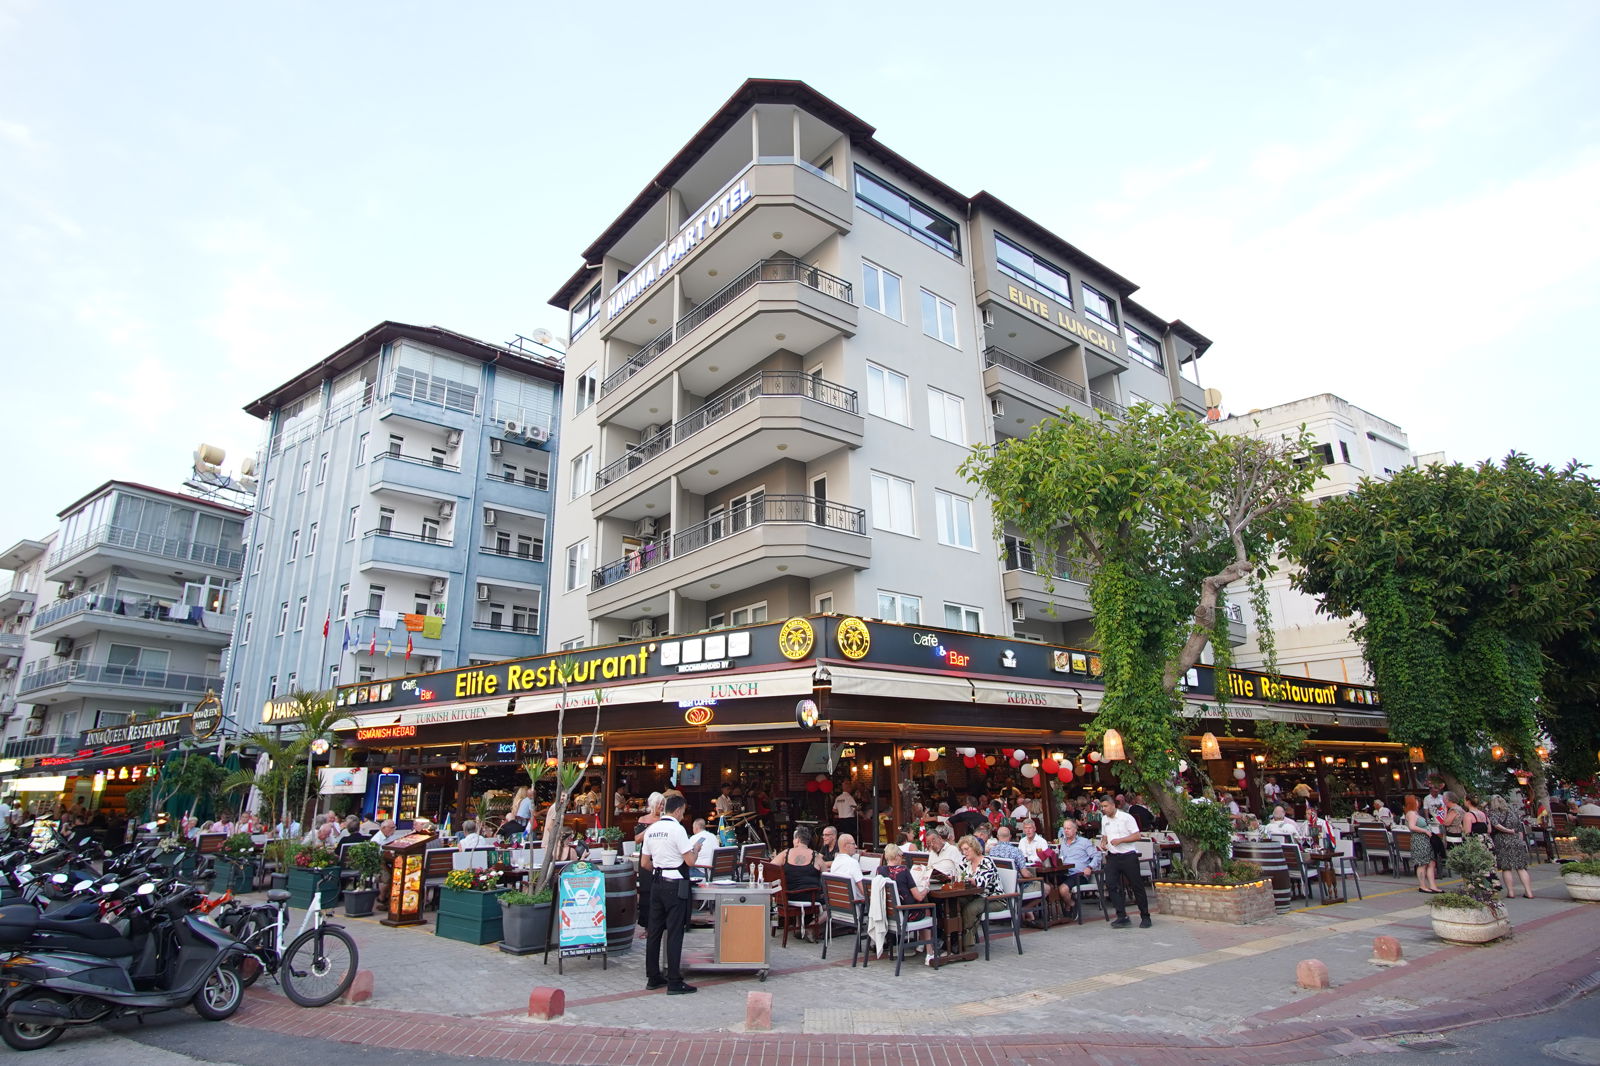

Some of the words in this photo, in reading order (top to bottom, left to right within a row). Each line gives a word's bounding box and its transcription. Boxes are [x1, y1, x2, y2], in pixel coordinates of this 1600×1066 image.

[607, 263, 656, 320] HAVANA
[658, 215, 706, 275] APART
[709, 179, 752, 229] OTEL
[1008, 285, 1049, 318] ELITE
[1058, 311, 1108, 350] LUNCH
[950, 651, 970, 668] Bar
[456, 671, 497, 697] Elite
[507, 646, 648, 691] Restaurant
[420, 690, 433, 700] Bar
[710, 682, 758, 698] LUNCH
[1218, 671, 1254, 697] lite
[1261, 676, 1335, 704] Restaurant
[554, 695, 579, 709] KDS
[1006, 691, 1047, 705] KEBABS
[416, 711, 448, 724] TURKISH
[451, 707, 487, 721] KITCHEN
[102, 728, 128, 745] QUEEN
[128, 720, 180, 741] RESTAURANT
[195, 720, 210, 731] HOTEL
[392, 725, 416, 737] KEBAB
